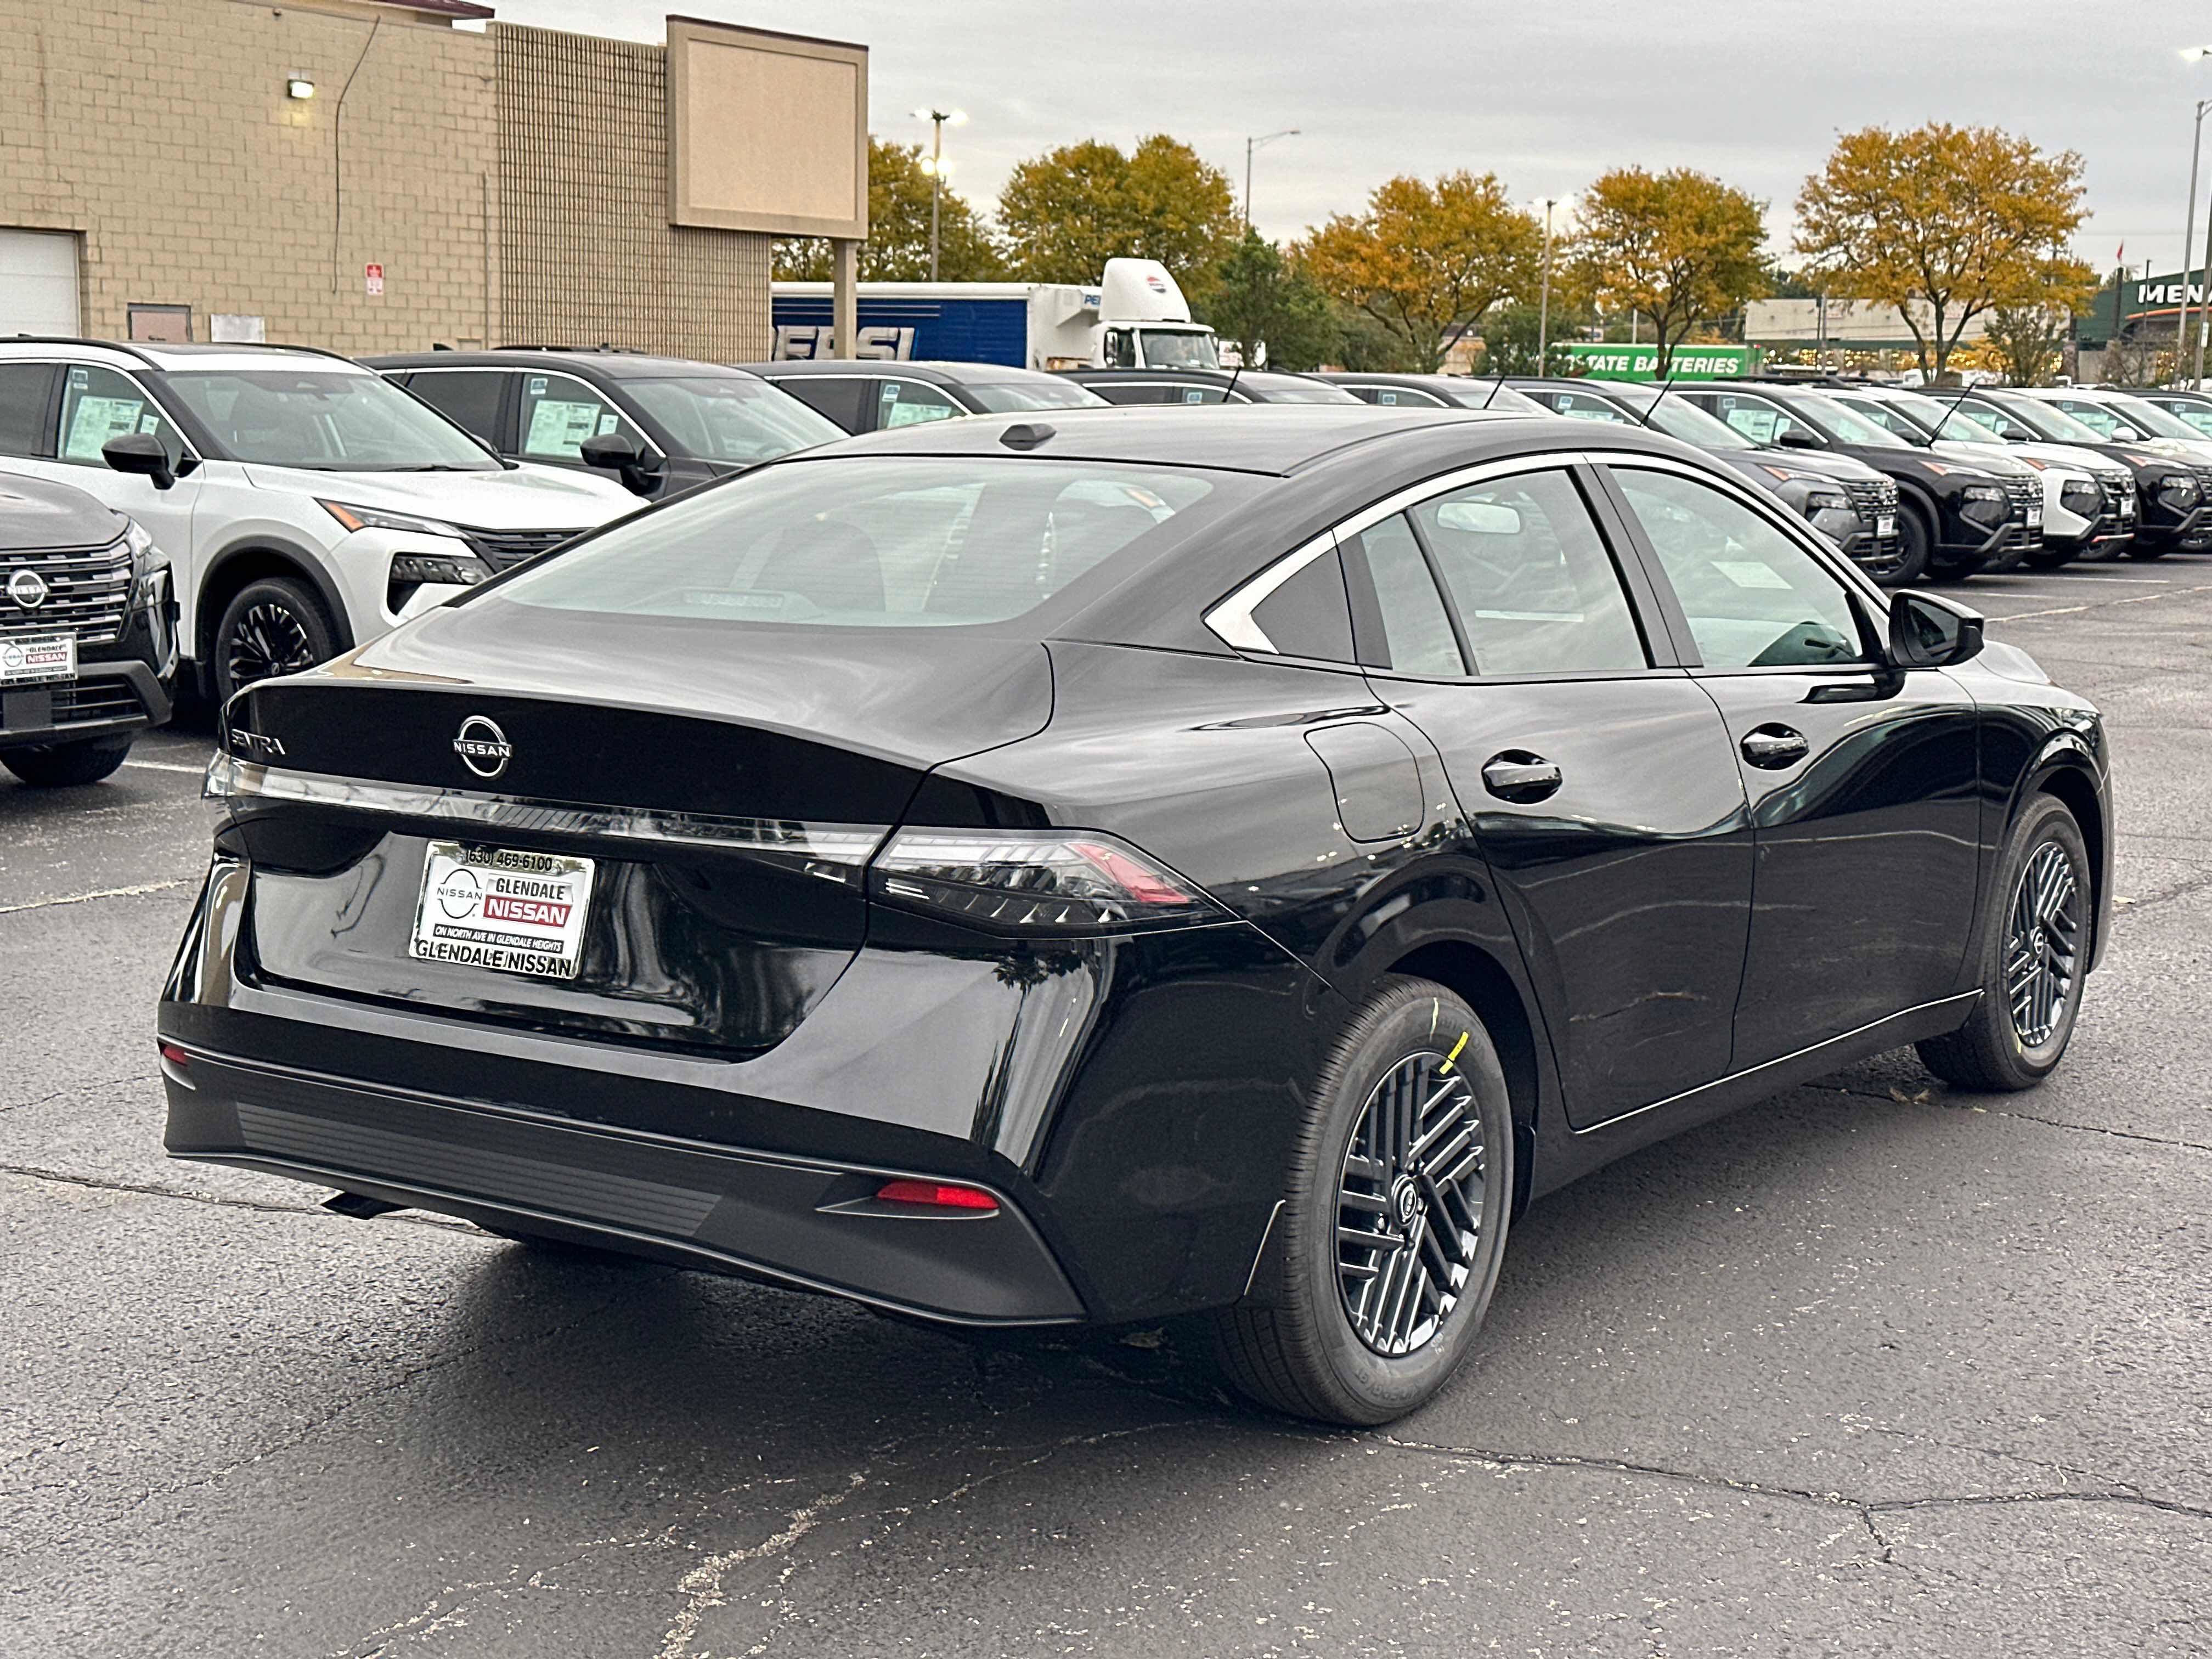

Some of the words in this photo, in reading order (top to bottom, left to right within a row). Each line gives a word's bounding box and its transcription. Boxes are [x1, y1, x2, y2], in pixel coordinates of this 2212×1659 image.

[772, 325, 915, 360] ESI
[1633, 356, 1738, 374] BATERIES
[453, 741, 510, 757] NISSAN
[466, 850, 493, 865] (630)
[497, 853, 552, 871] 469-6100
[437, 887, 482, 900] NISSAN
[496, 878, 566, 900] GLENDALE
[488, 899, 566, 925] NISSAN
[435, 926, 447, 936] ON
[447, 927, 472, 939] NORTH
[472, 931, 487, 941] AVE
[487, 933, 496, 943] IN
[496, 934, 532, 948] GLENDALE
[532, 939, 562, 952] HEIGHTS
[416, 939, 504, 967] GLENDALE
[508, 952, 571, 978] NISSAN
